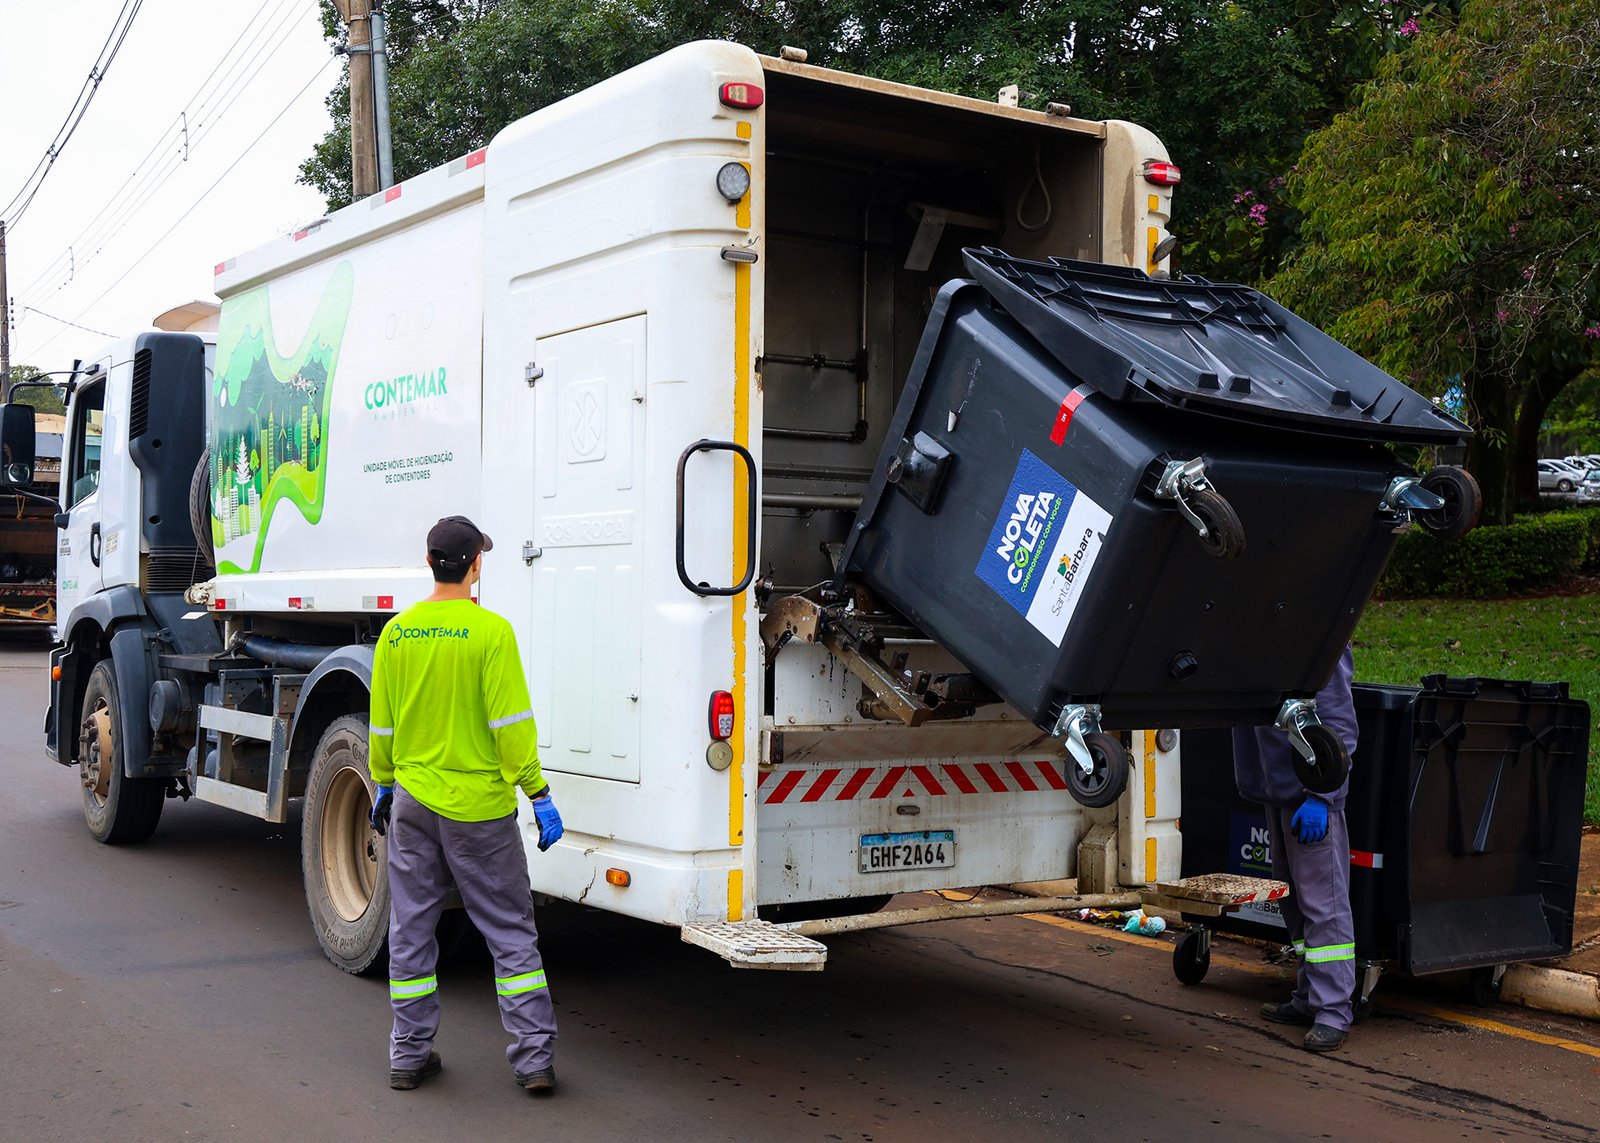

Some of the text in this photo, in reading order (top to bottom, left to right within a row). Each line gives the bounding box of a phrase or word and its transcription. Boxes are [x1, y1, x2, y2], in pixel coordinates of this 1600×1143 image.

[365, 366, 448, 410] CONTEMAR
[363, 450, 454, 473] UNIDADE MÓVEL DE HIGIENIZAÇÃO
[384, 469, 431, 484] DE CONTENTORES
[996, 492, 1035, 561] NOVA
[1007, 491, 1055, 586] COLETA
[1020, 539, 1045, 593] COMPROMISSO
[1043, 520, 1053, 539] COM
[403, 626, 469, 639] CONTEMAR
[870, 843, 945, 868] GHF2A64
